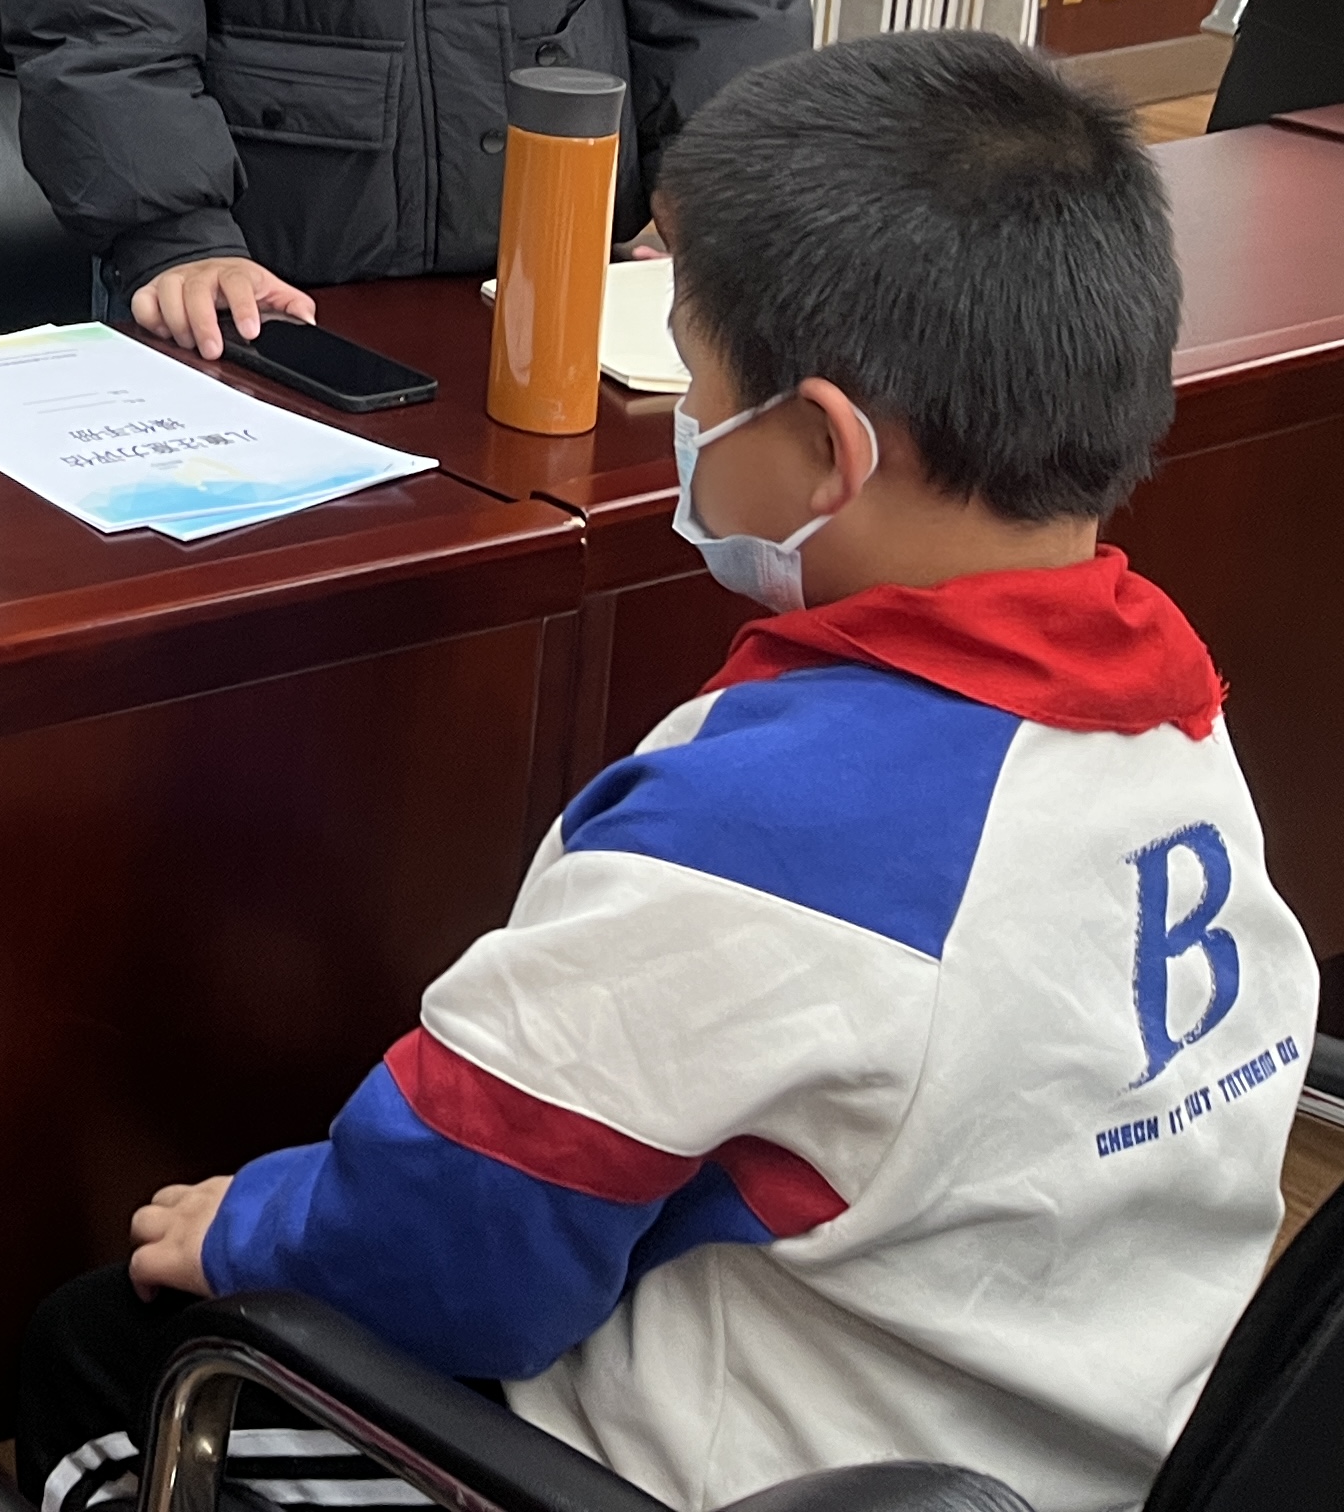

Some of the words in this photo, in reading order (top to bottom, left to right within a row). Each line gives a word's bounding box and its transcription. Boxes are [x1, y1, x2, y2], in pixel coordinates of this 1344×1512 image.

[60, 429, 258, 468] 儿童注意力评估
[1123, 821, 1240, 1092] B
